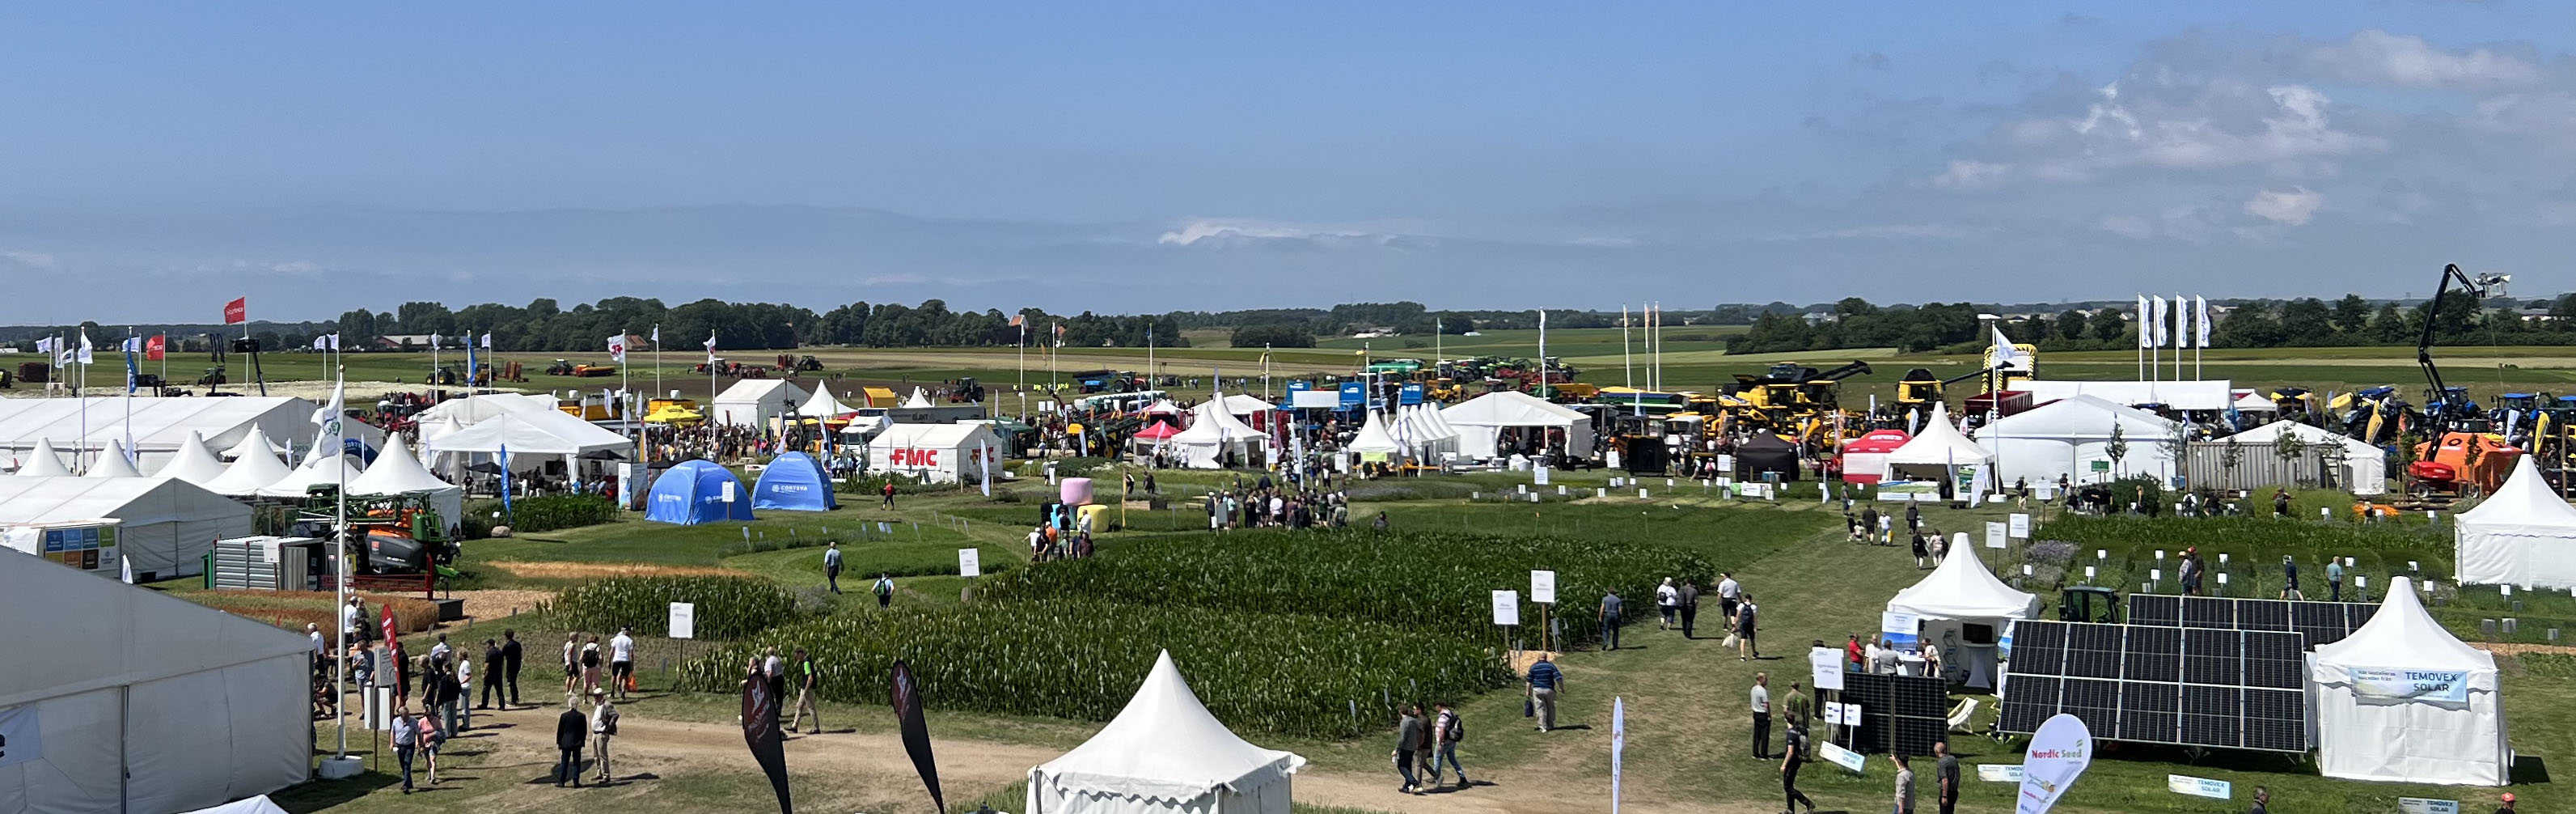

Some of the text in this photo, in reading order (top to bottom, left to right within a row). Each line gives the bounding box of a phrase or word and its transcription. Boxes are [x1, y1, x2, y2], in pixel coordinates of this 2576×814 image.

[890, 448, 937, 467] FMC
[2405, 672, 2458, 682] TEMOVEX
[2413, 683, 2450, 692] SOLAR
[2032, 748, 2083, 759] Nordic Seed
